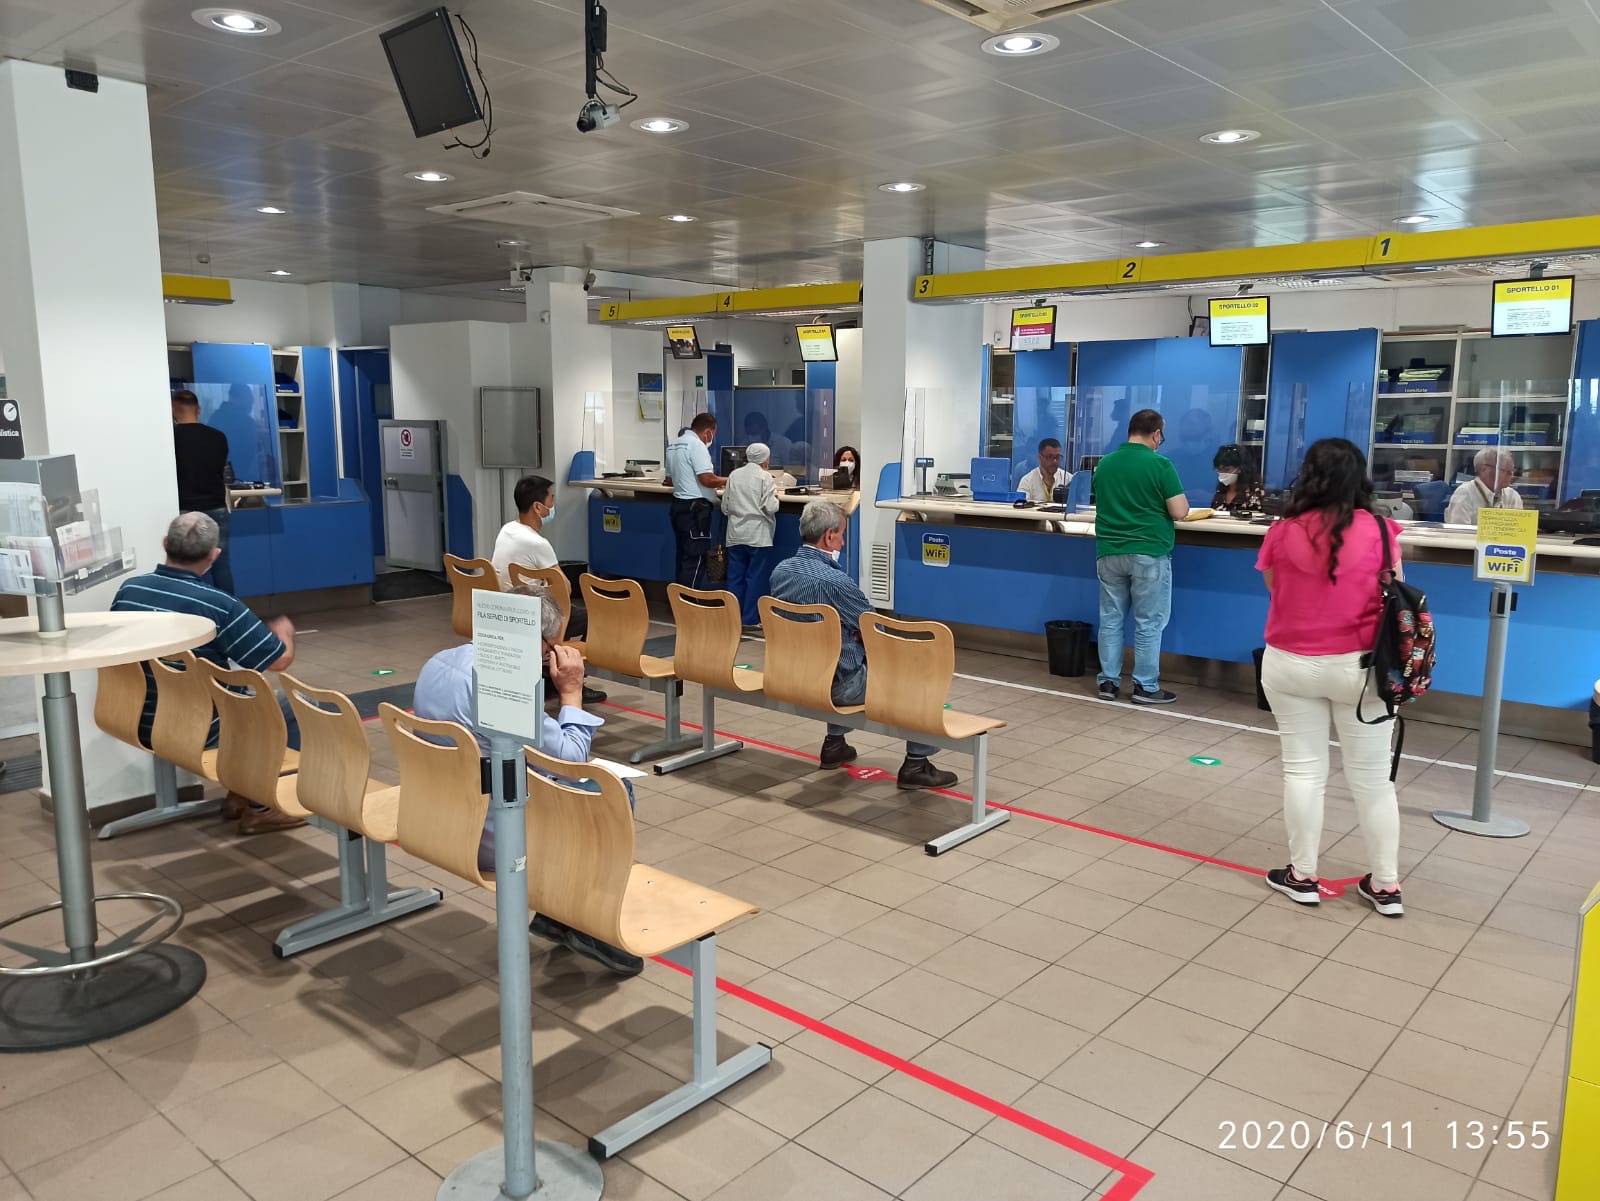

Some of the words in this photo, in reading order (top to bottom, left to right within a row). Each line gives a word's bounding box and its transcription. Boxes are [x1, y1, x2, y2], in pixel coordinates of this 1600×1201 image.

[1381, 237, 1391, 257] 1
[1122, 261, 1137, 279] 2
[919, 279, 929, 294] 3
[1506, 285, 1550, 294] SPORTELLO
[723, 295, 731, 308] 4
[1218, 302, 1252, 310] SPORTELLO
[608, 305, 616, 318] 5
[926, 548, 946, 559] WiFi
[1493, 547, 1517, 556] Poste
[1487, 561, 1519, 573] WiFi
[509, 616, 536, 626] SPORTELLO
